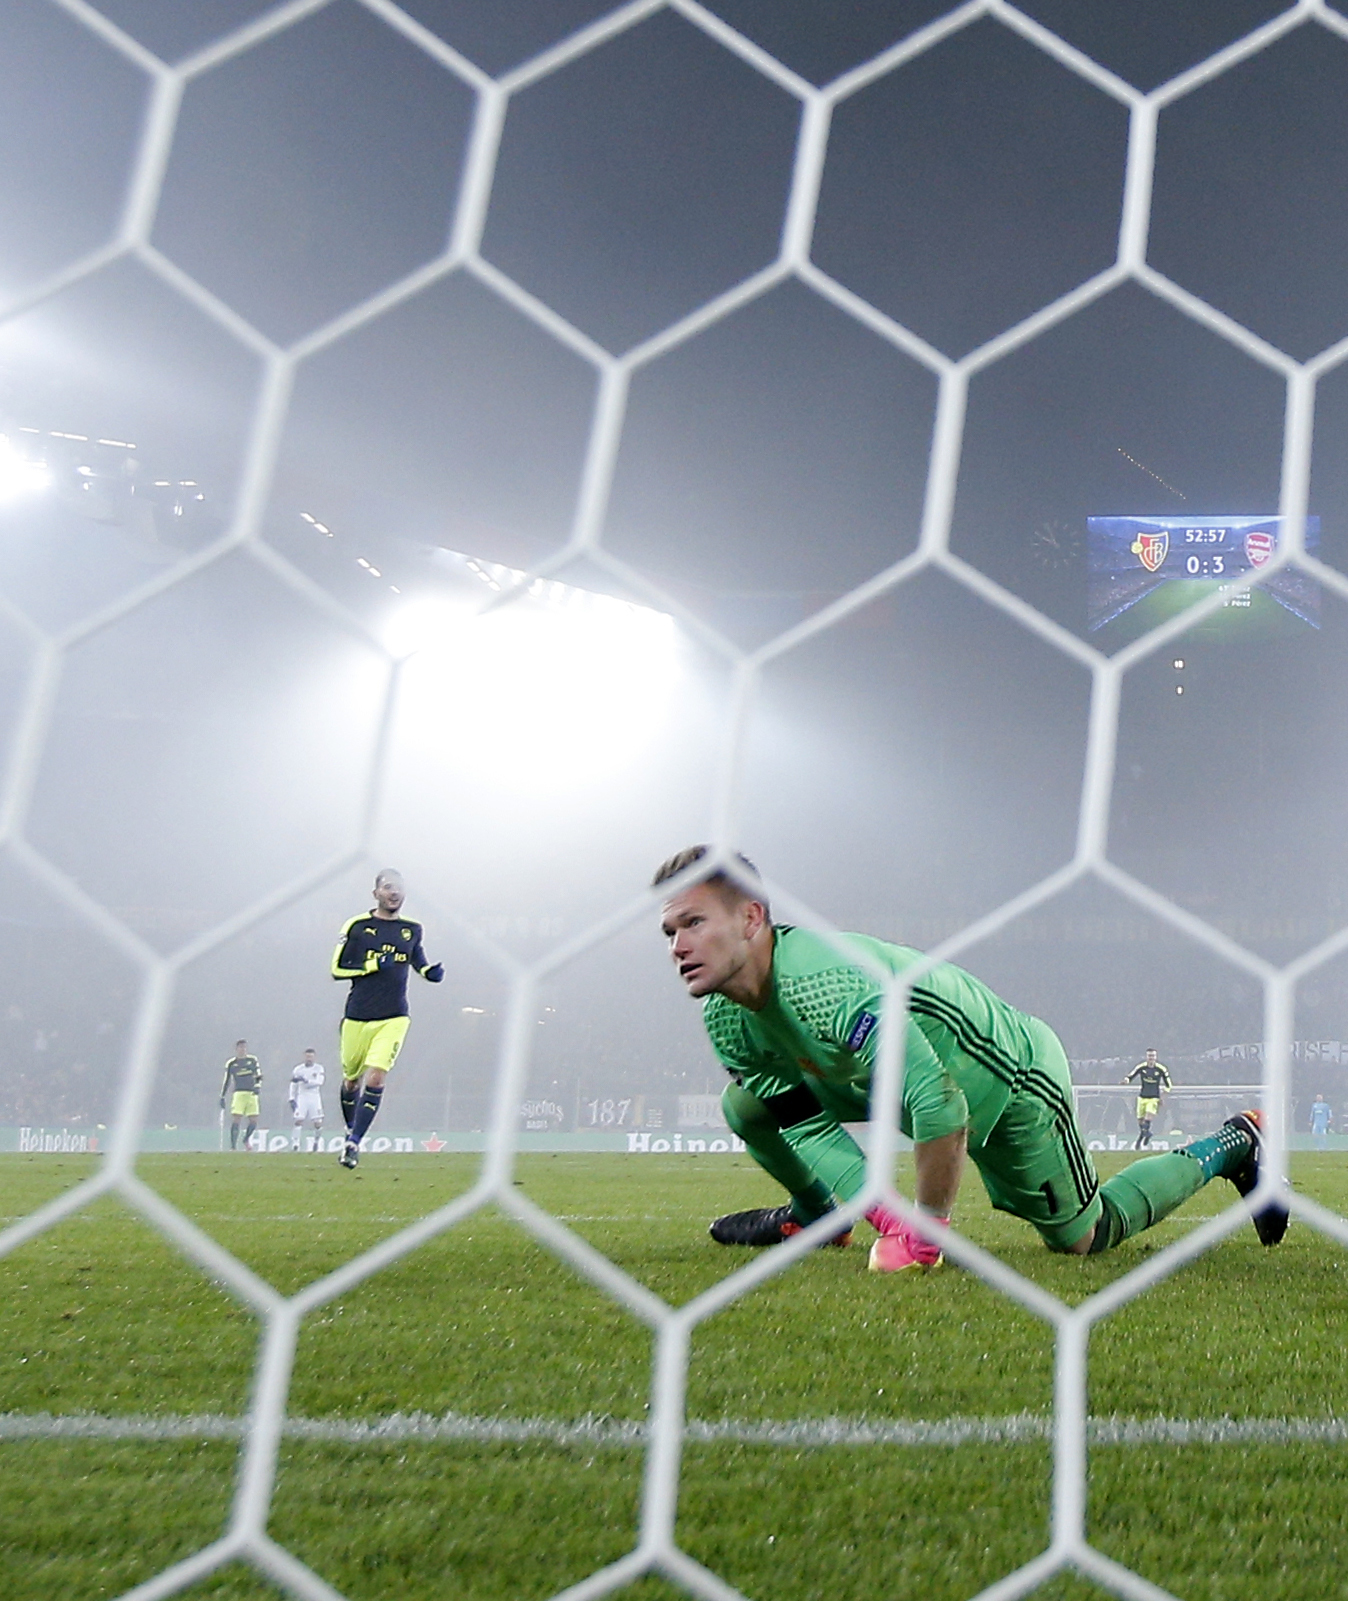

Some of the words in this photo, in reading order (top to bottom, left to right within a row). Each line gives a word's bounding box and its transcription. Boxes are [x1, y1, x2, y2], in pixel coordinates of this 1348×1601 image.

[1186, 530, 1226, 542] 52:57
[520, 1100, 564, 1122] sychos
[588, 1098, 631, 1125] 187
[20, 1127, 87, 1152] Heineken
[249, 1129, 414, 1152] Heneken
[626, 1132, 747, 1153] Heinek
[1038, 1180, 1058, 1216] 1
